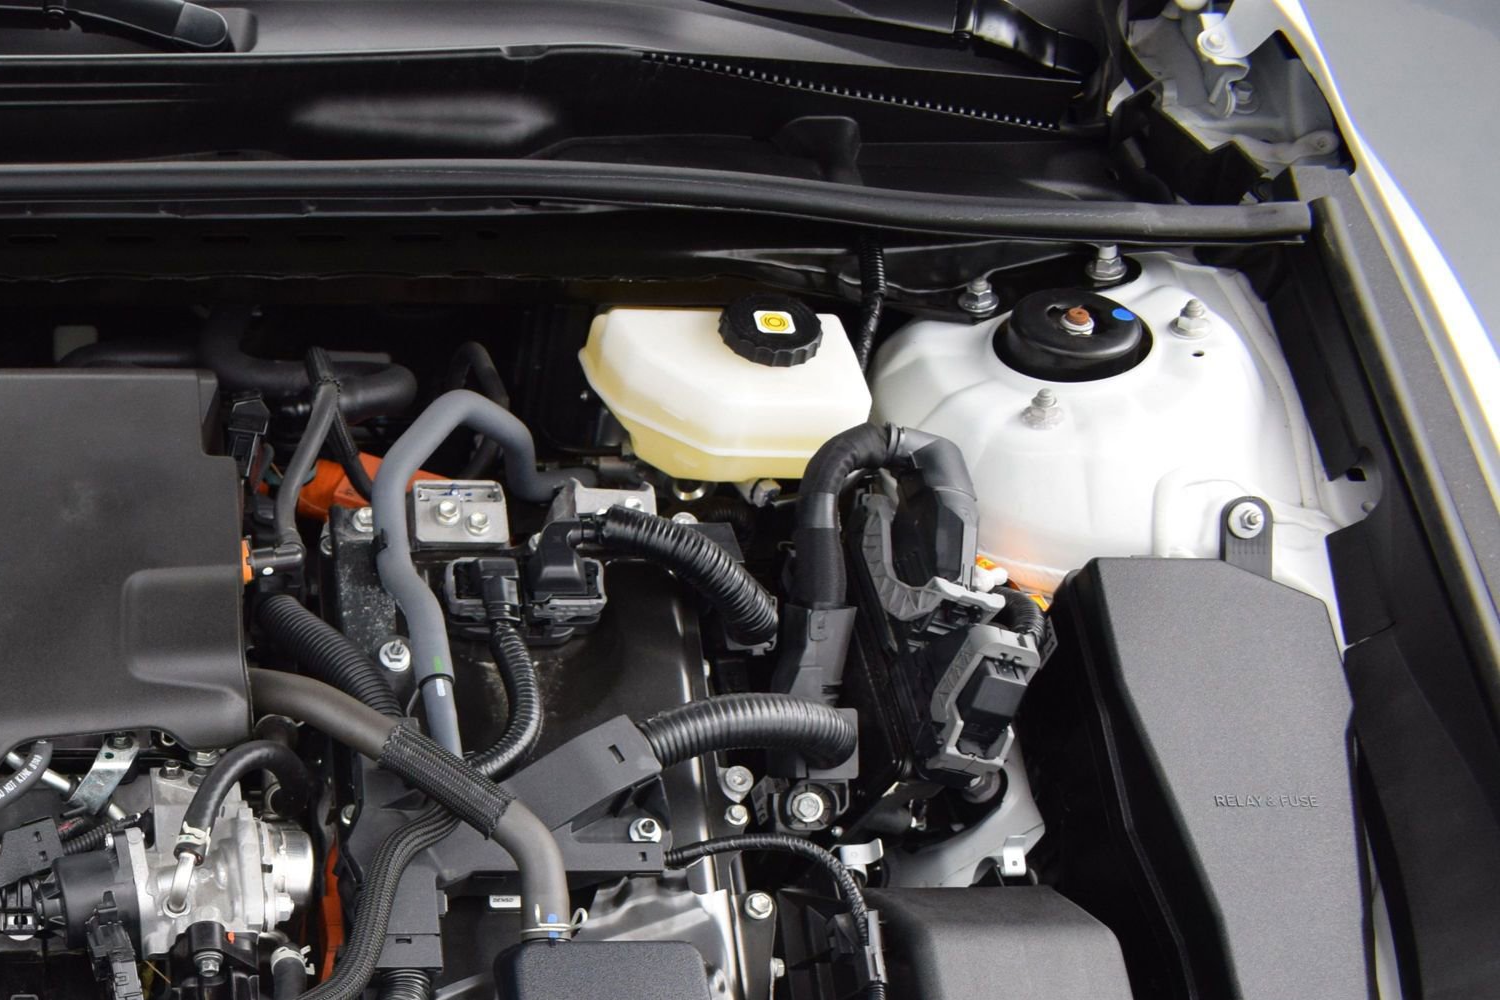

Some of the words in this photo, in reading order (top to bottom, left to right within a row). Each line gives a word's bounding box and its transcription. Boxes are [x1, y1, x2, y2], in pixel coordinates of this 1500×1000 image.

[2, 779, 18, 794] NOT
[14, 767, 34, 784] KINK
[1213, 793, 1263, 809] RELAY
[1264, 794, 1277, 808] &
[1279, 793, 1320, 809] FUSE
